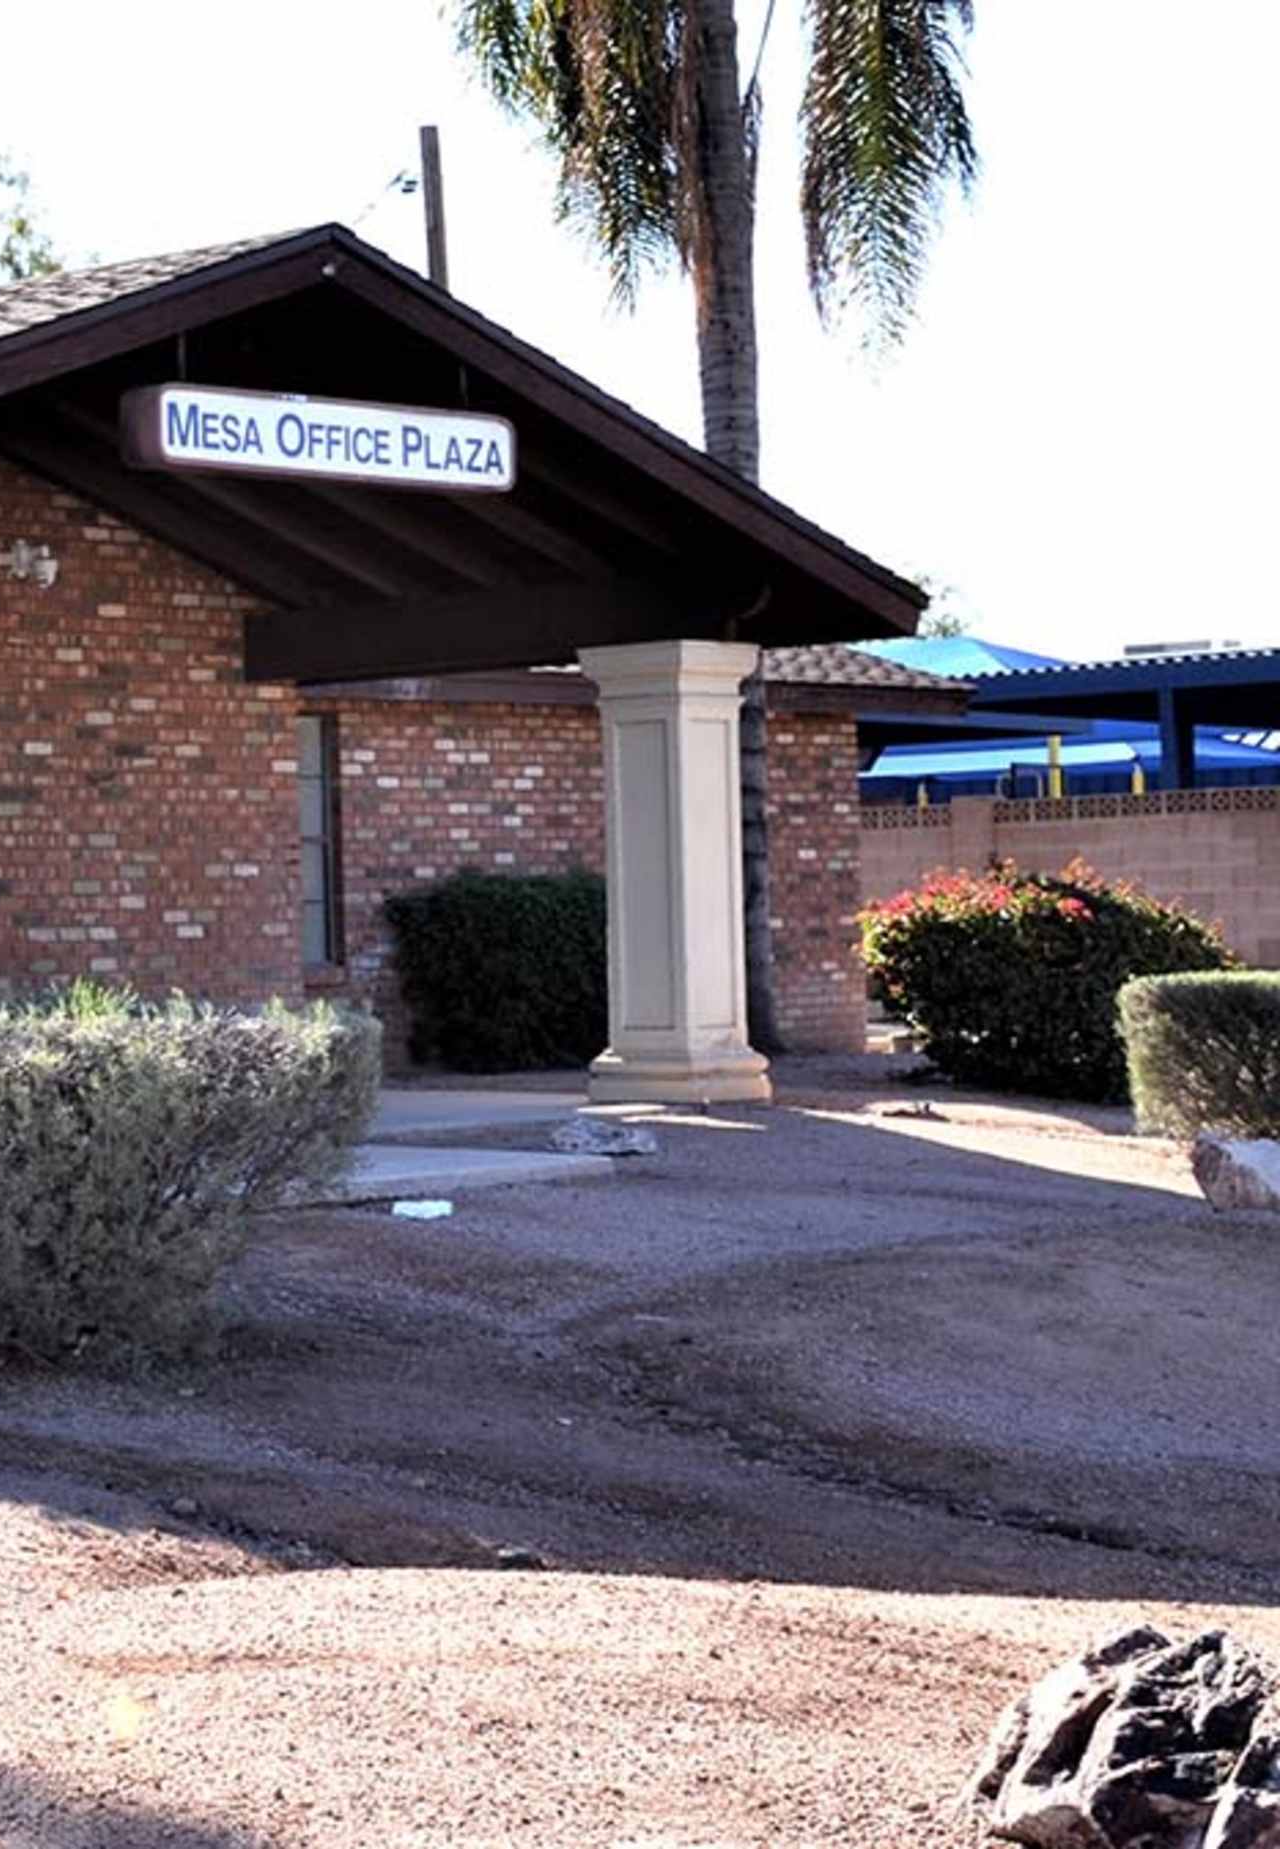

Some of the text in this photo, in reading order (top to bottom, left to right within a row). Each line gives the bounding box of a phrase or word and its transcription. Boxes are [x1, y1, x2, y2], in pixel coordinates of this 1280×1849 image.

[166, 401, 504, 475] MESA OFFICE PLAZA
